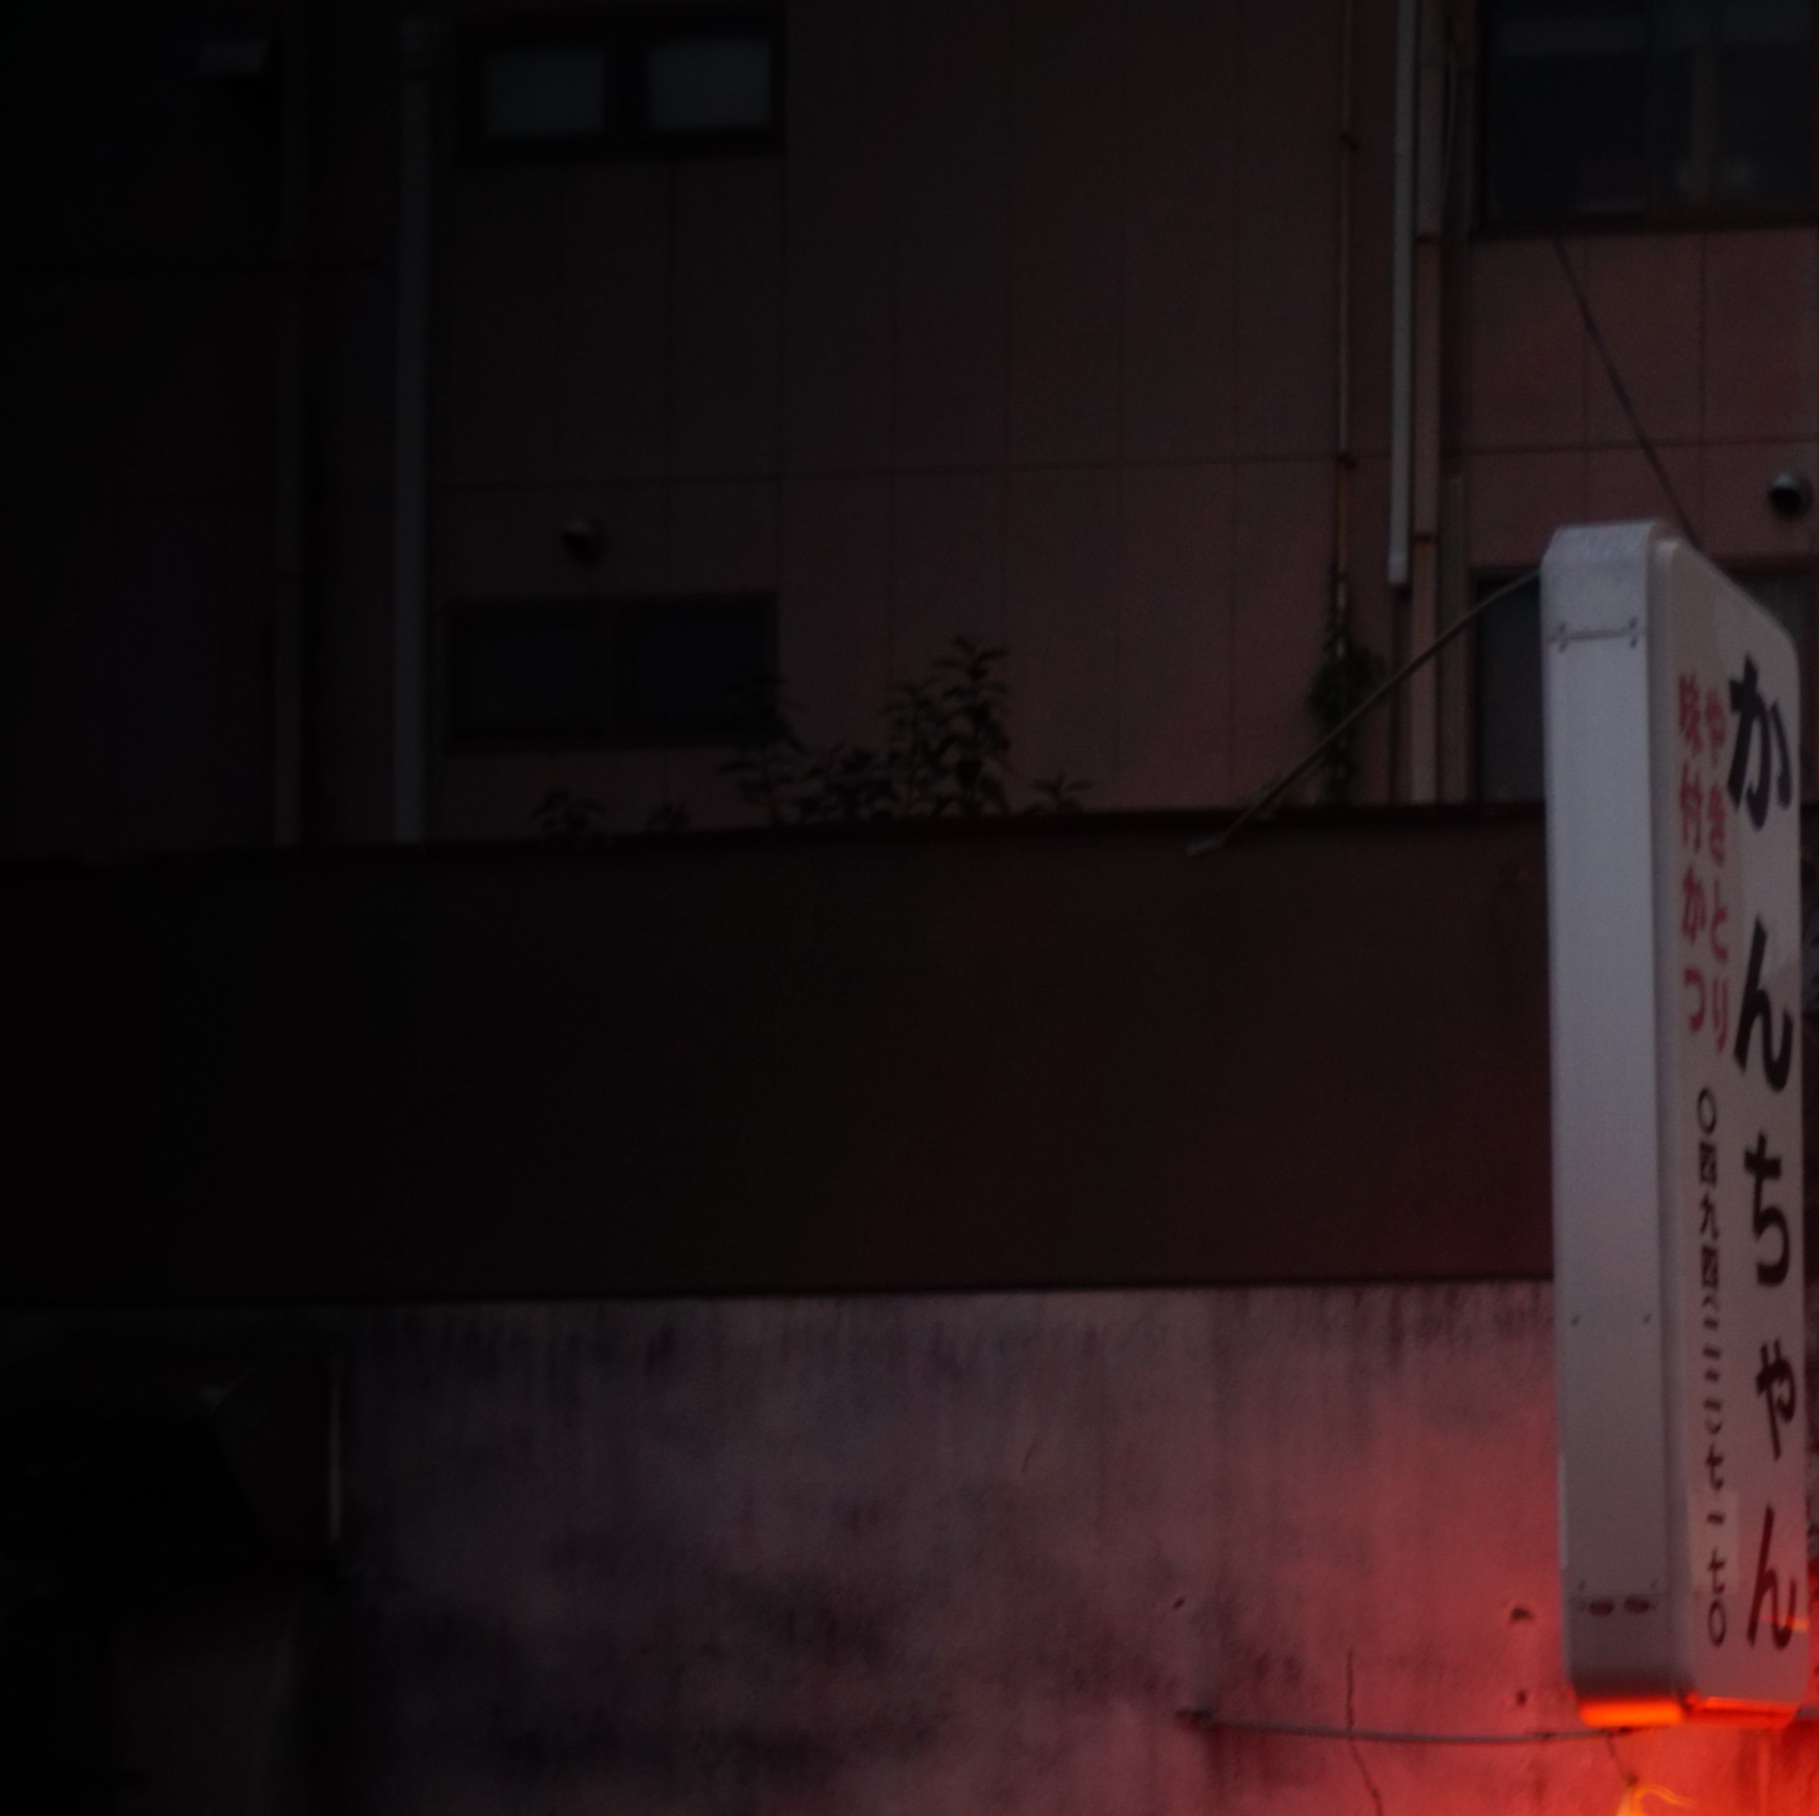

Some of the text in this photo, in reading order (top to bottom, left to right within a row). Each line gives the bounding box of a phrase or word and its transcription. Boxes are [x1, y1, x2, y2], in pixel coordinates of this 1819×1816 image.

[1704, 686, 1728, 1055] やきとり
[1728, 653, 1798, 1651] かんちゃん
